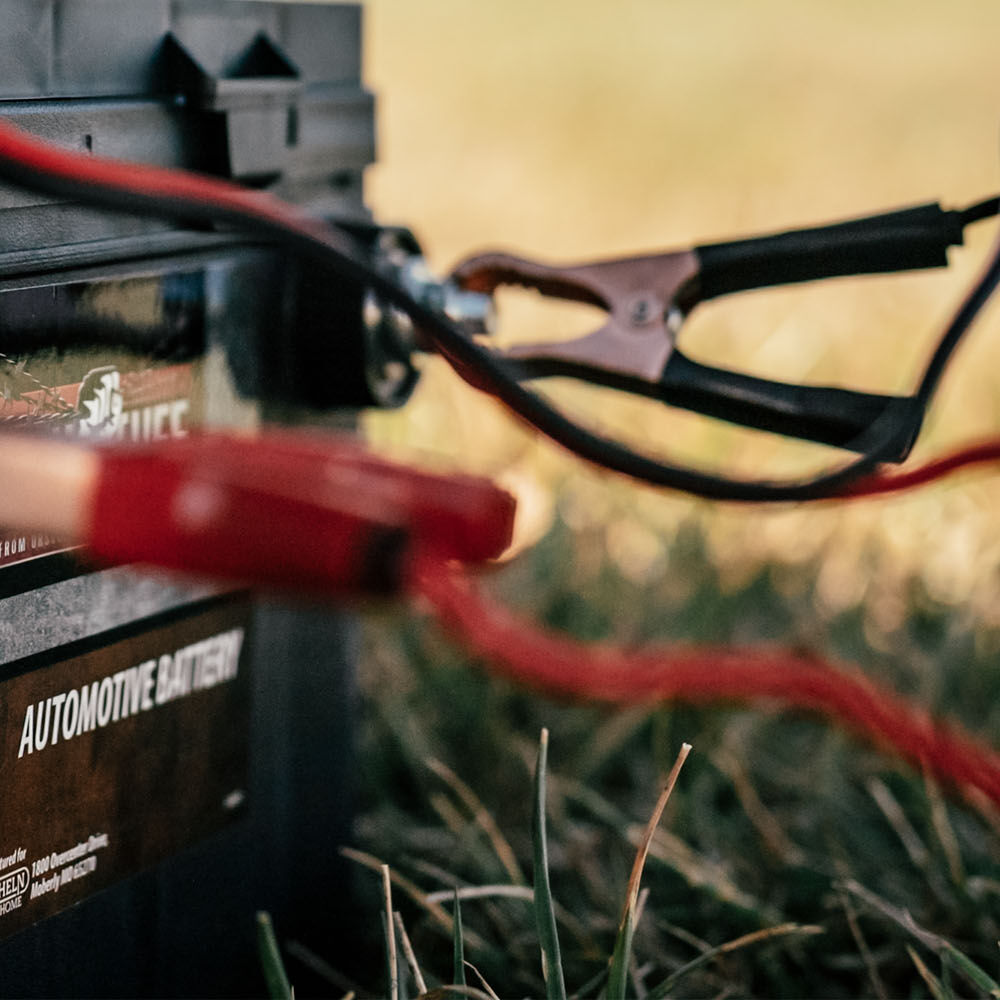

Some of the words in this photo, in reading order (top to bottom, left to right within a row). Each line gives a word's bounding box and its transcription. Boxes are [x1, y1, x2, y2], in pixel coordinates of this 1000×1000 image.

[18, 660, 157, 759] AUTOMOTIVE
[155, 627, 245, 705] BATTERY
[17, 847, 27, 863] for
[0, 896, 22, 916] HOME
